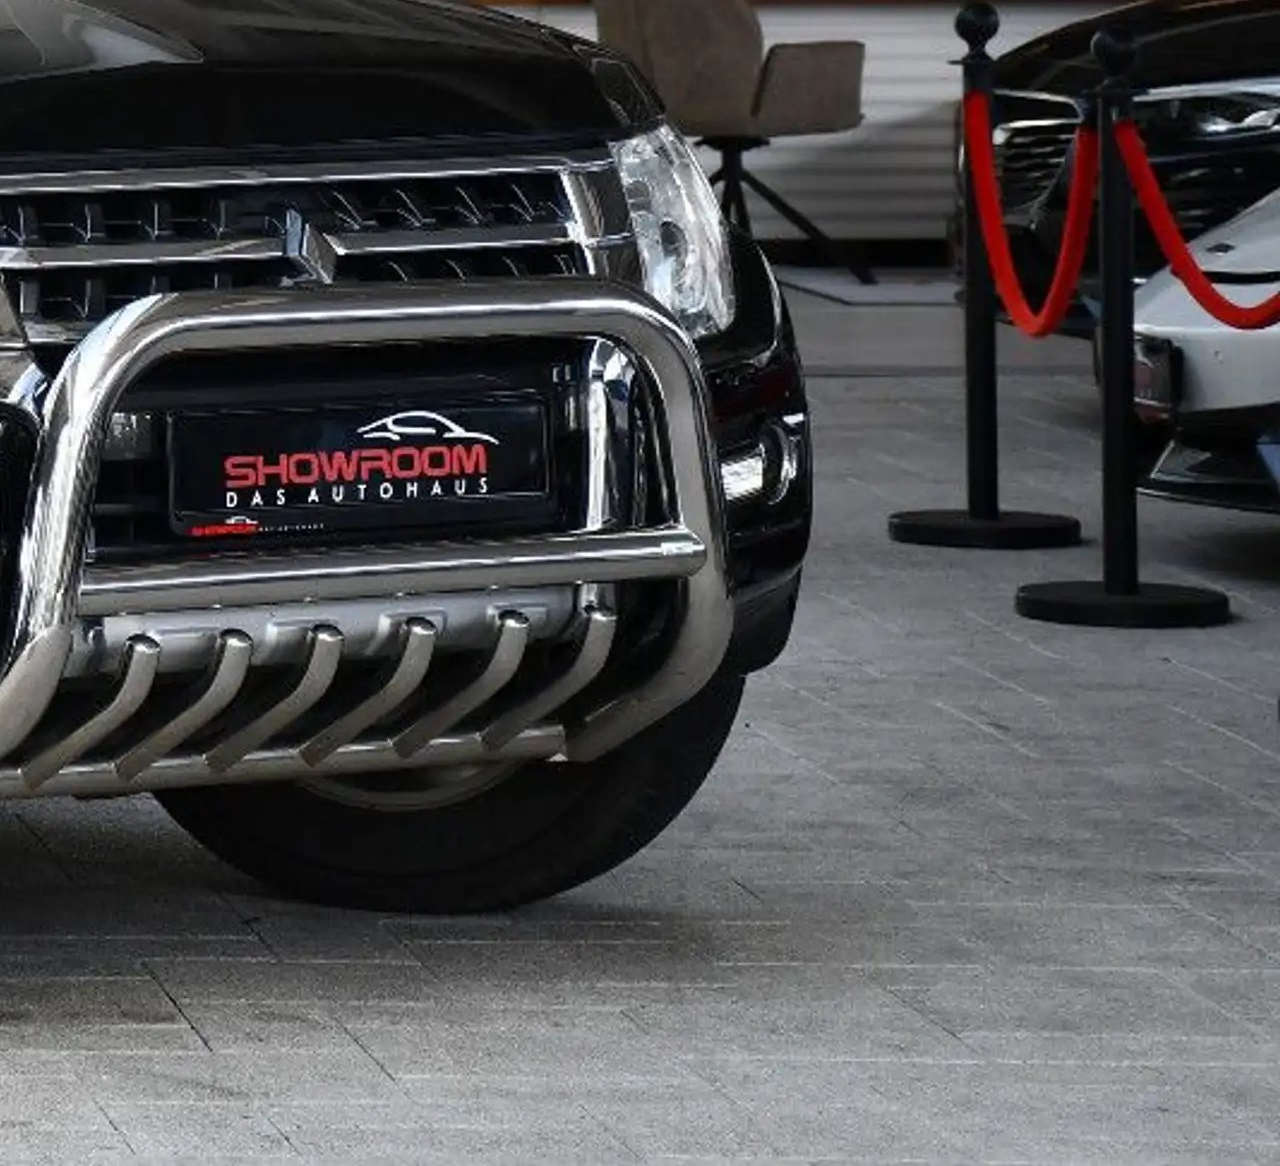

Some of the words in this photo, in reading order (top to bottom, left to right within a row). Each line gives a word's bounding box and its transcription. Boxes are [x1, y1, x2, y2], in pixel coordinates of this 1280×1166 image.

[224, 444, 487, 488] SHOWROOM
[226, 489, 287, 509] DAS
[307, 477, 489, 503] AUTOHAUS
